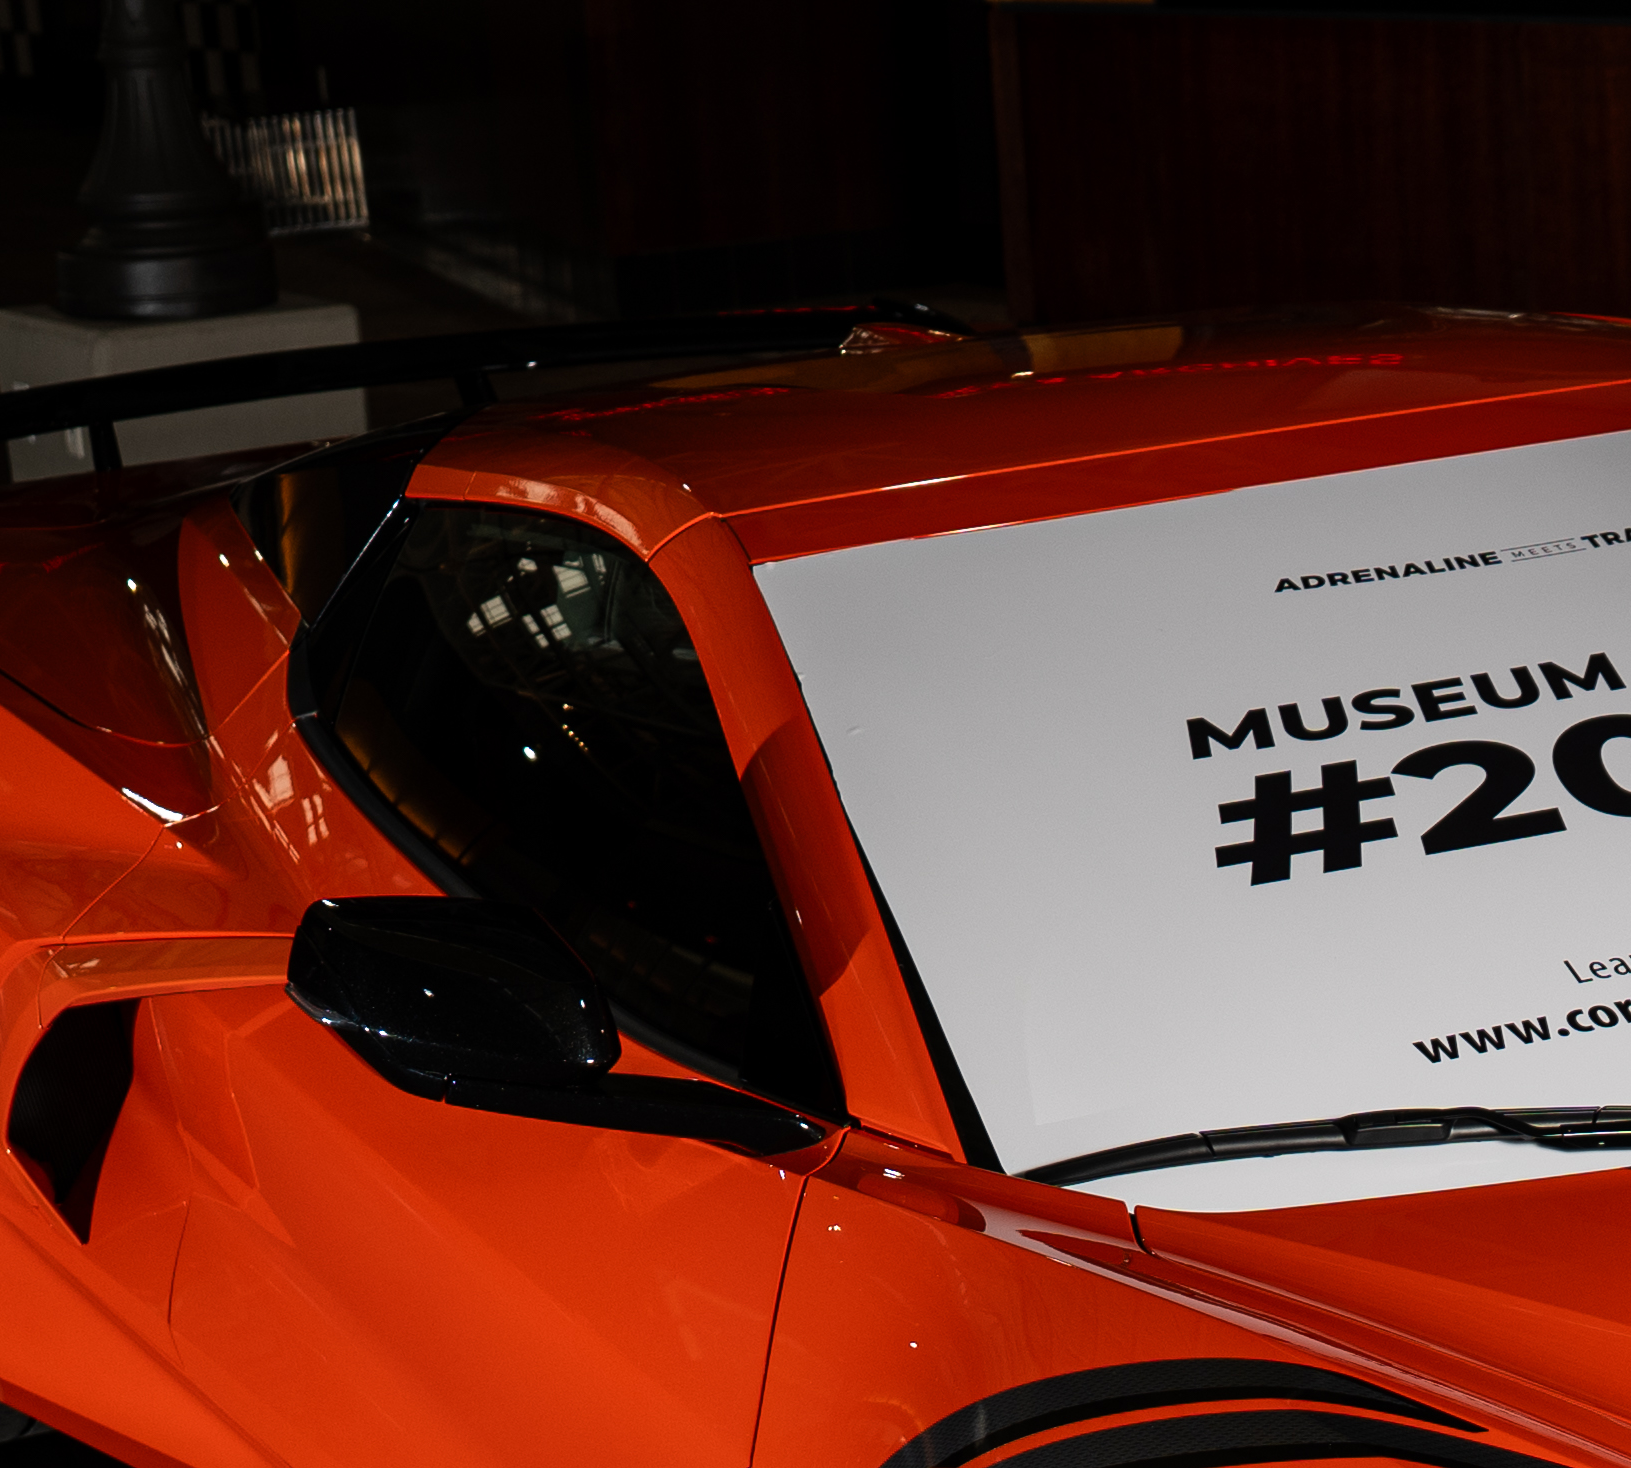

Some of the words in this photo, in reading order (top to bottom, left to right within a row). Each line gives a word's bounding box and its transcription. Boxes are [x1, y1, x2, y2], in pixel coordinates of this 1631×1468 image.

[1274, 550, 1503, 592] ADRENALINE
[1511, 541, 1576, 560] MEETS
[1186, 652, 1625, 759] MUSEUM
